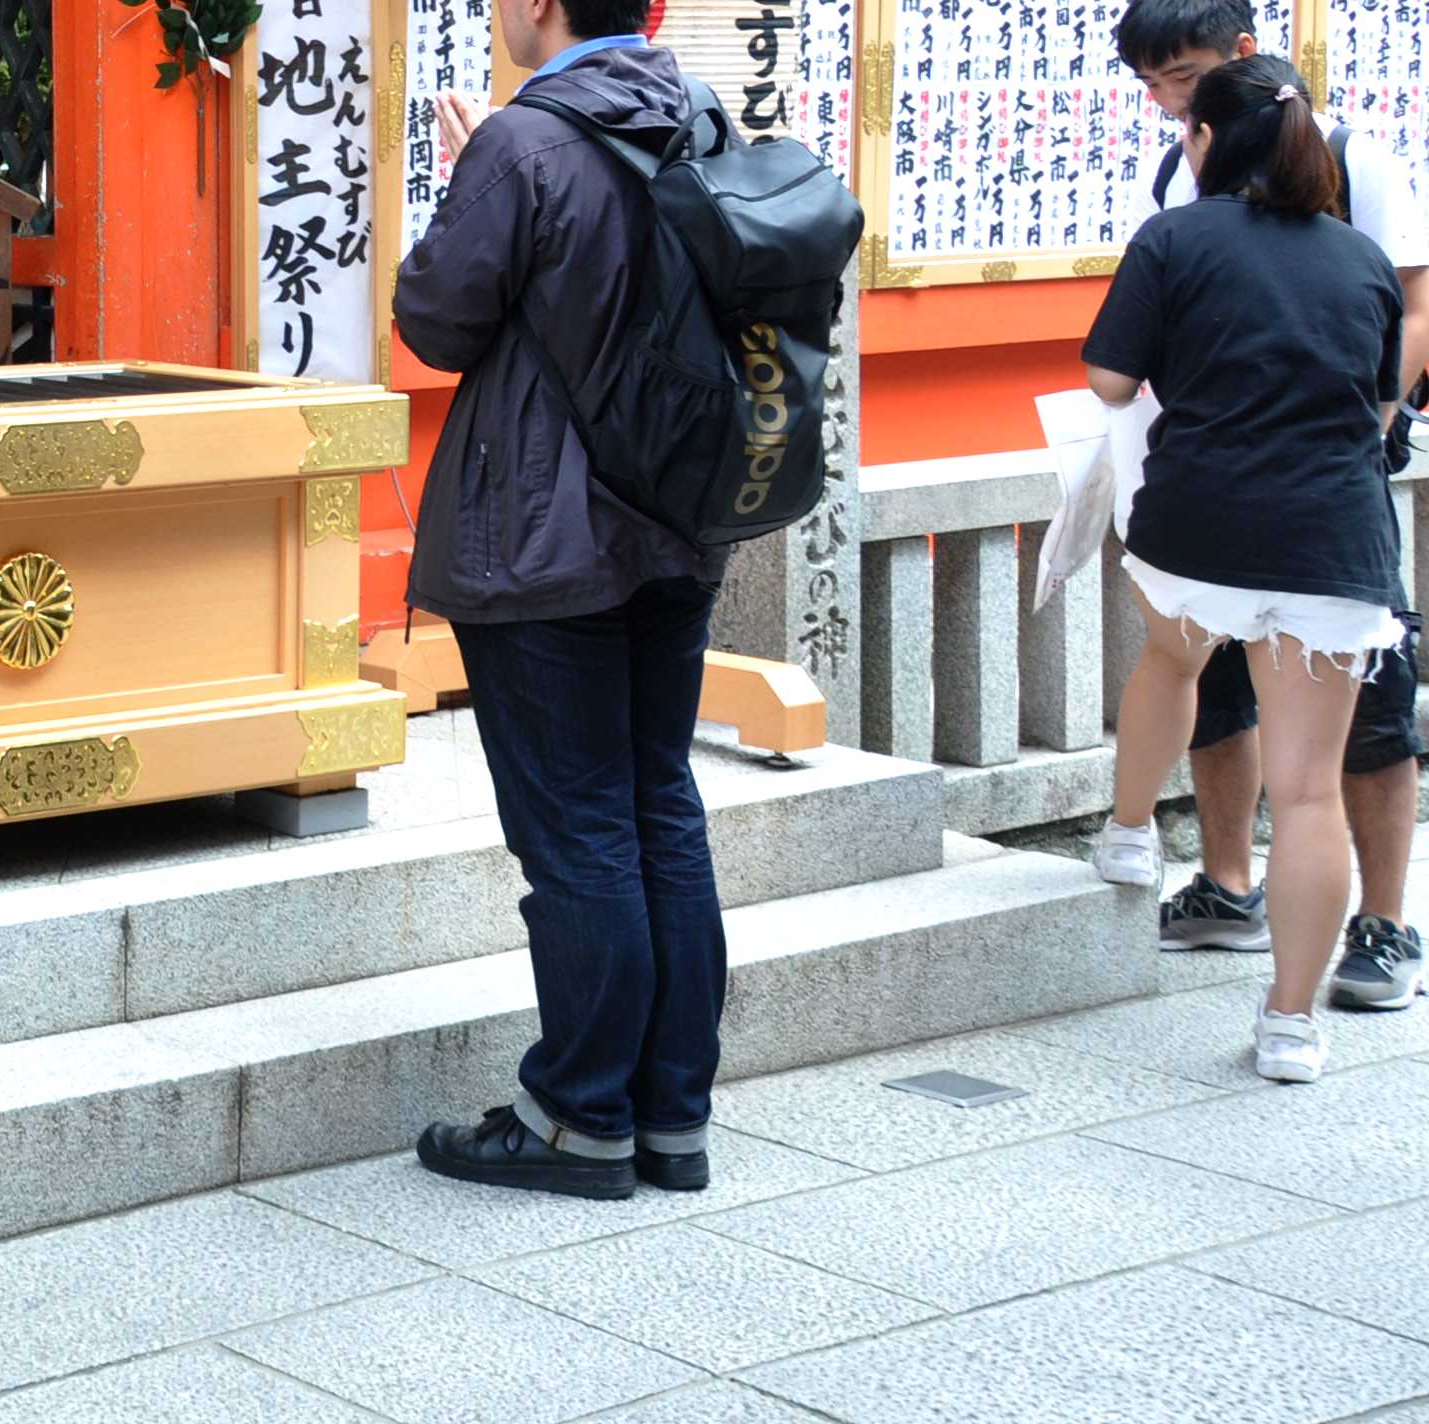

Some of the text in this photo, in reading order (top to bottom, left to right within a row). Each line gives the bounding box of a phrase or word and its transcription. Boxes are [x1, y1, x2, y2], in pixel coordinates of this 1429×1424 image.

[333, 34, 372, 268] えんむすび
[406, 97, 436, 205] 静岡市
[896, 91, 917, 176] 大阪市
[934, 91, 959, 181] 川崎市
[1009, 89, 1035, 186] 大分県
[1050, 90, 1071, 181] 松江市
[258, 35, 336, 376] 地主祭り
[734, 323, 789, 514] adidas
